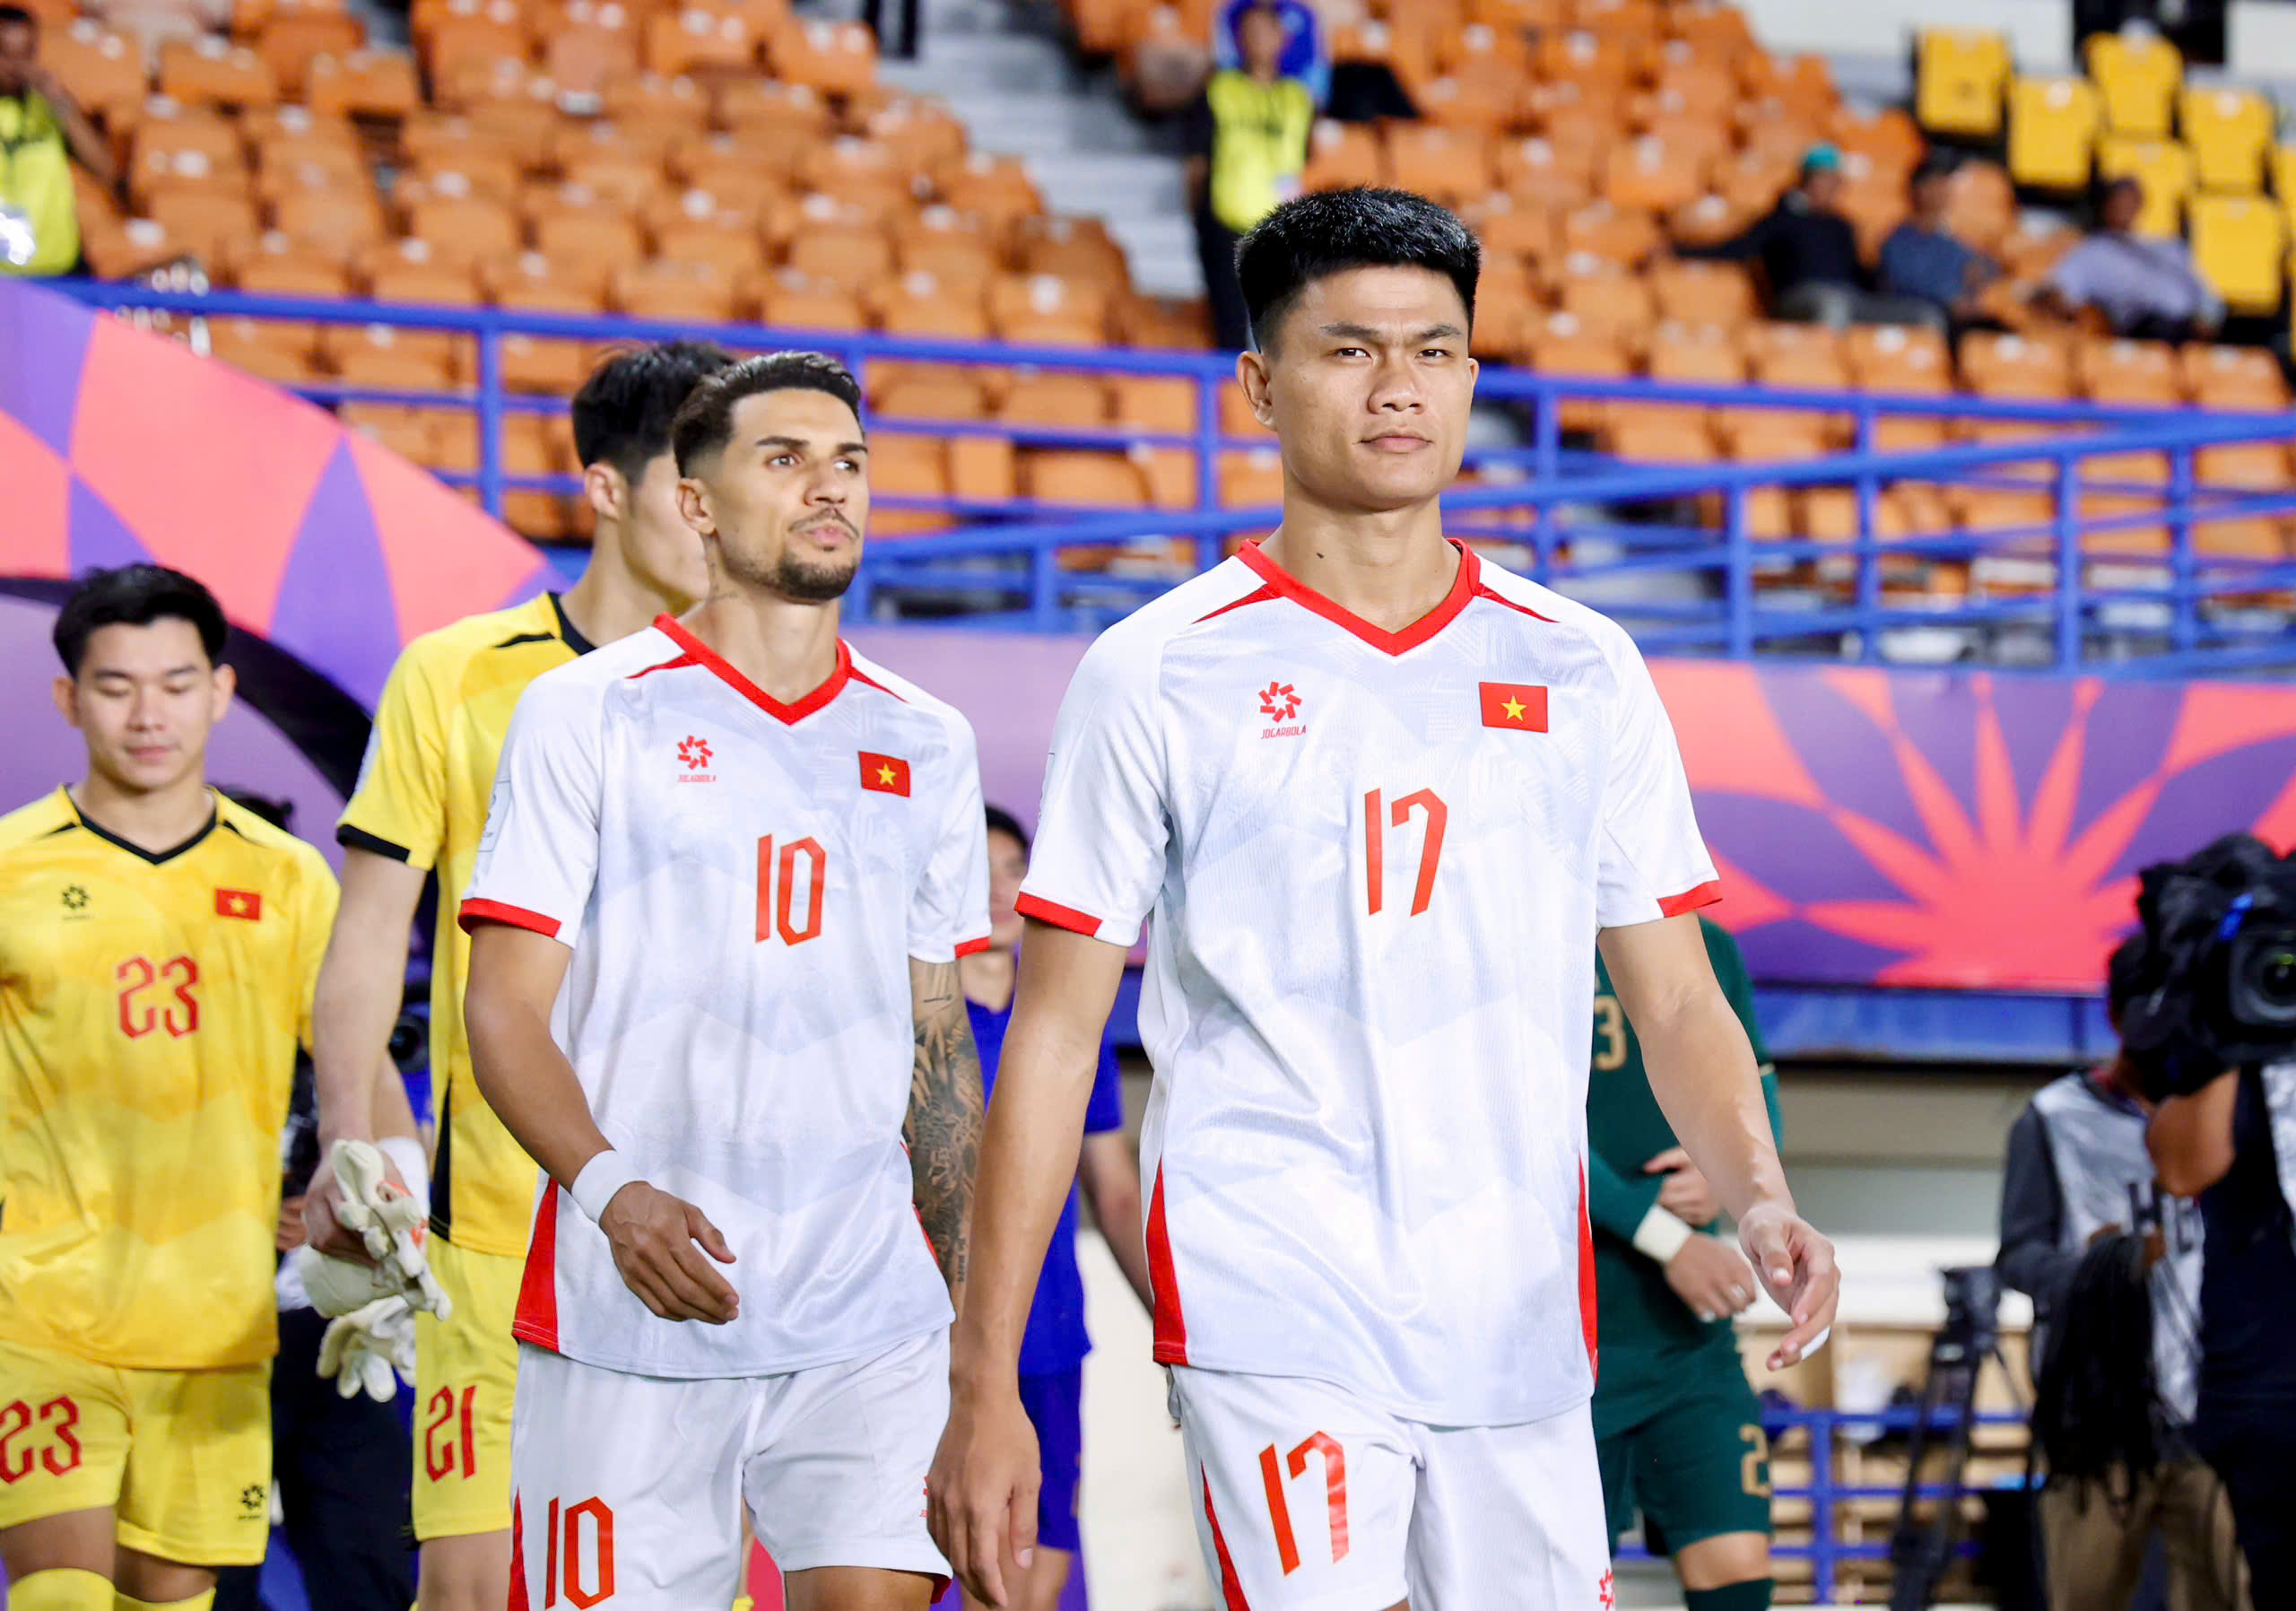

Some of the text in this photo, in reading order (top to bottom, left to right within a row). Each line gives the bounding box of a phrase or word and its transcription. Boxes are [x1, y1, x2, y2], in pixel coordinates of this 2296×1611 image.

[755, 833, 826, 947] 10
[1364, 787, 1448, 917] 17
[117, 954, 199, 1041] 23
[0, 1394, 83, 1485] 23
[425, 1384, 476, 1485] 21
[544, 1495, 615, 1611] 10
[1258, 1430, 1350, 1578] 17
